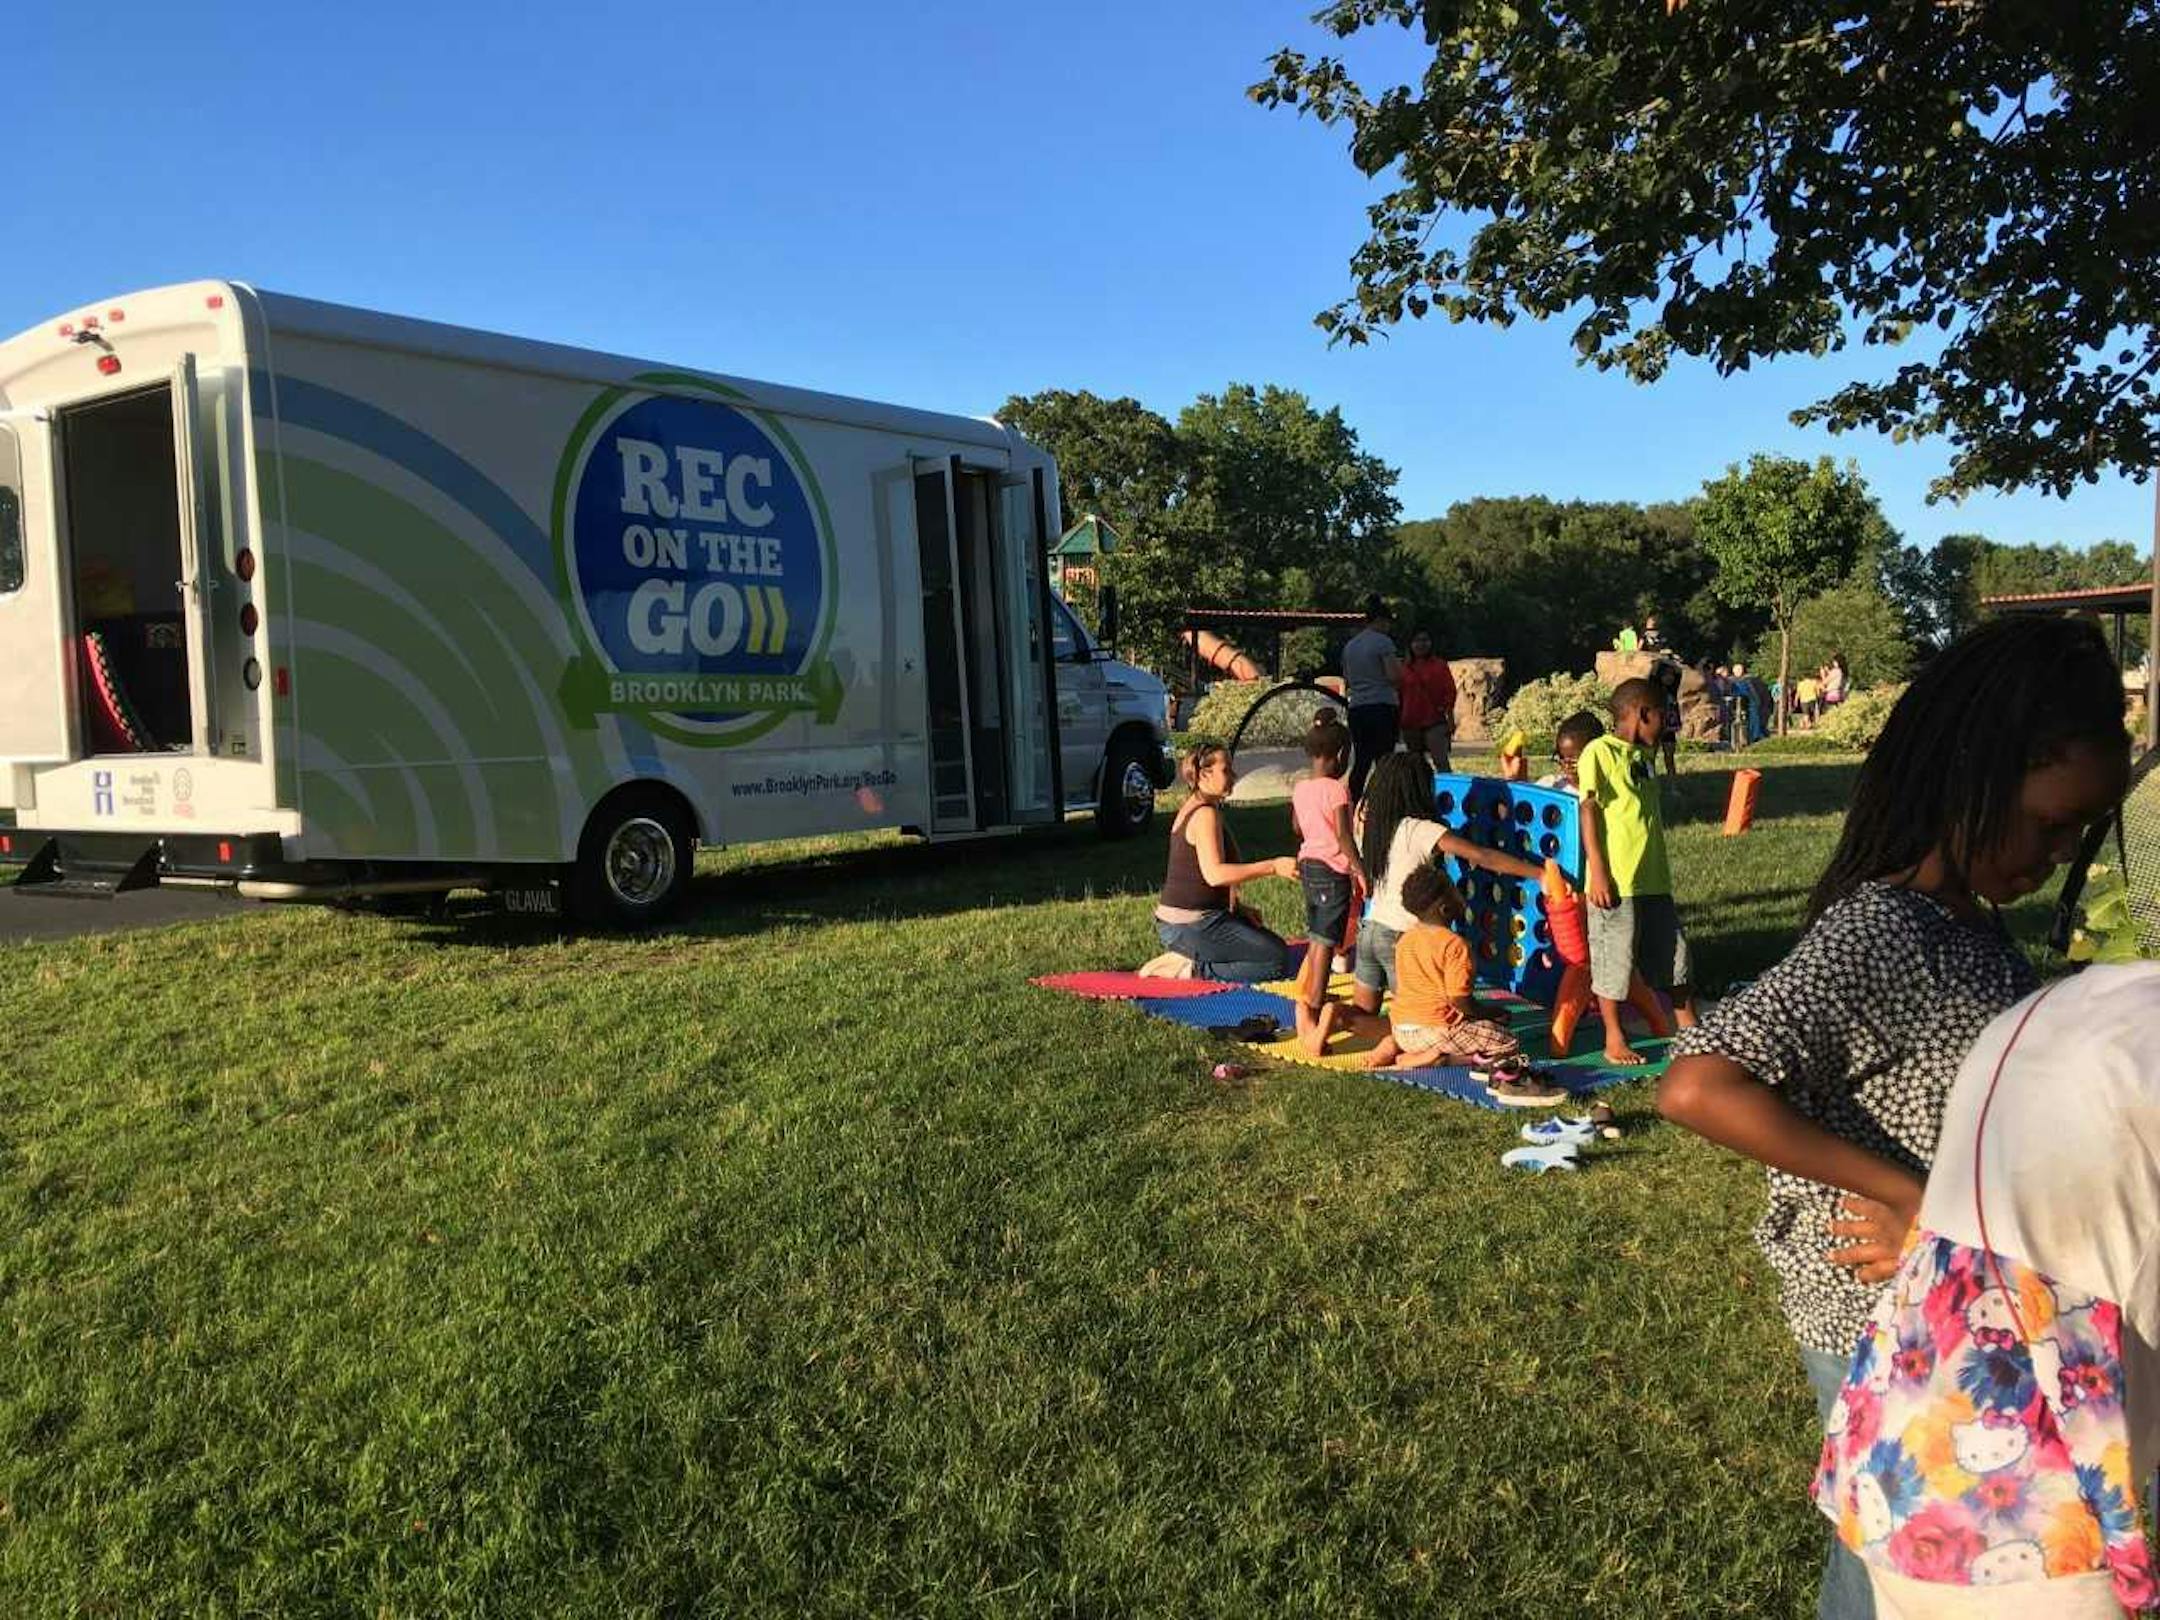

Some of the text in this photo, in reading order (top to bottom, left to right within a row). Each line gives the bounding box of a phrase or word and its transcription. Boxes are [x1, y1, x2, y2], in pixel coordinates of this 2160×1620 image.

[616, 437, 775, 527] REC
[622, 524, 784, 576] ON THE
[627, 578, 744, 656] GO
[611, 682, 809, 702] BROOKLYN PARK
[505, 890, 557, 912] GLAVAL
